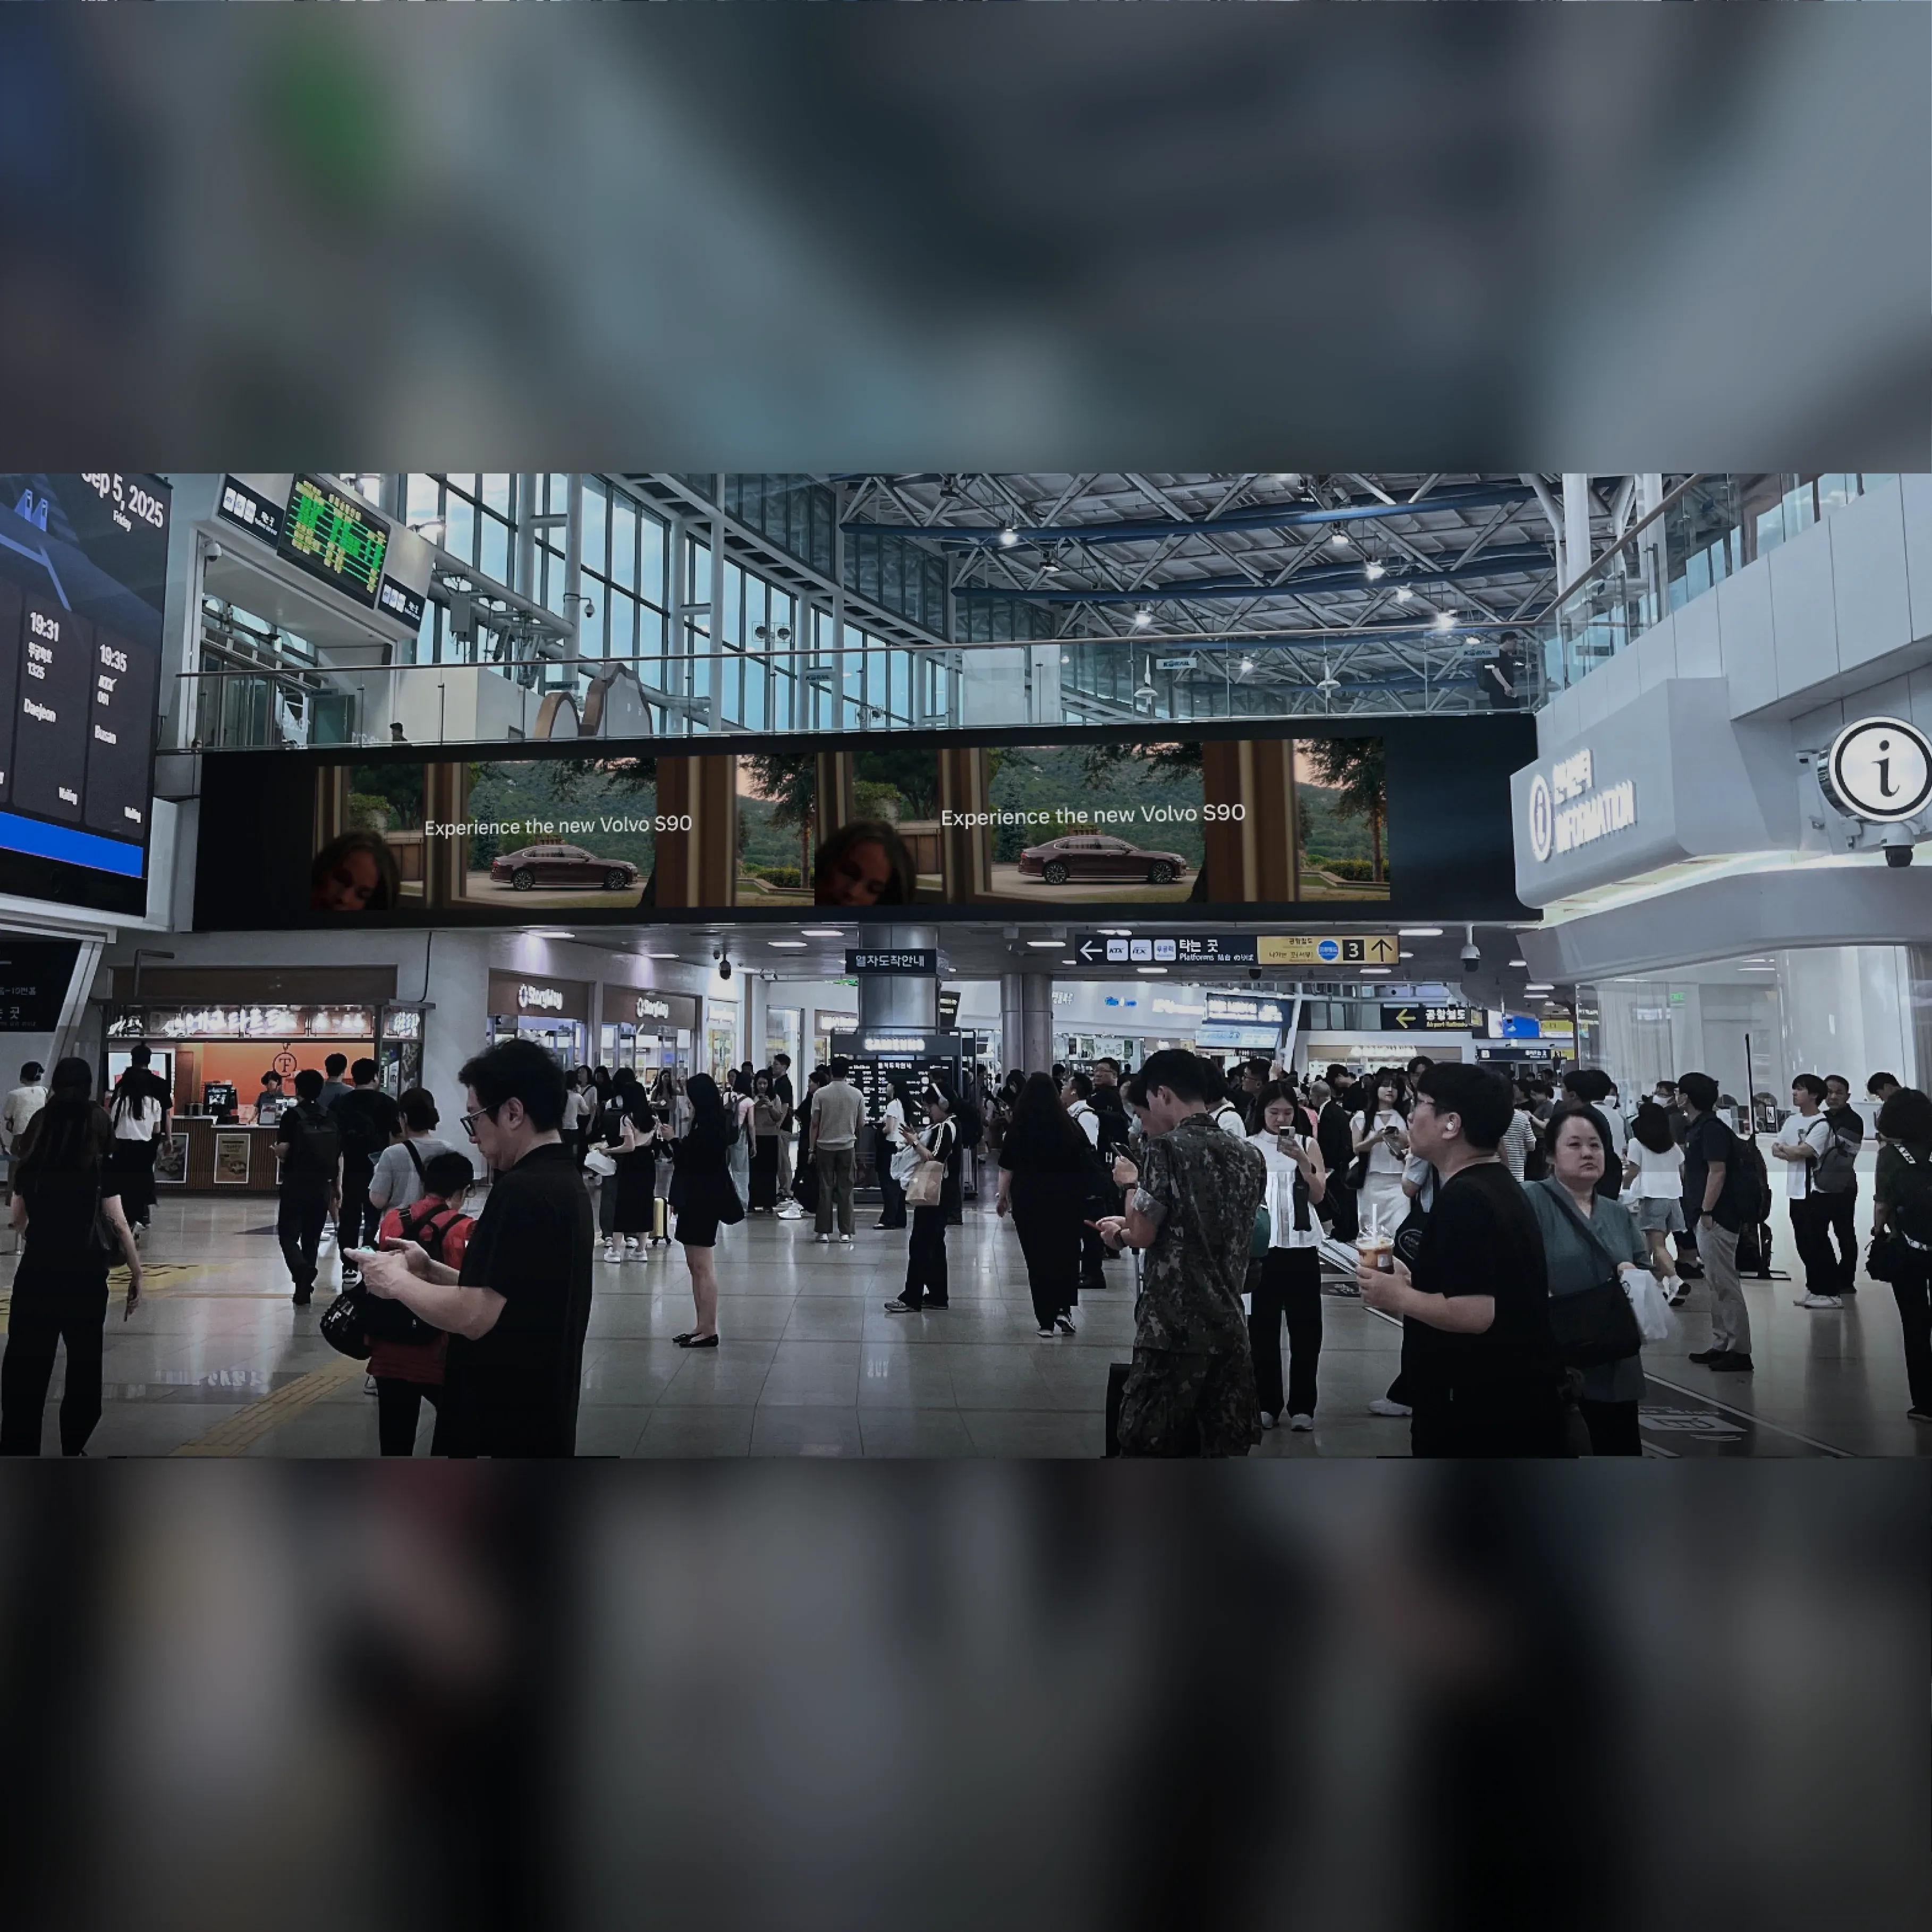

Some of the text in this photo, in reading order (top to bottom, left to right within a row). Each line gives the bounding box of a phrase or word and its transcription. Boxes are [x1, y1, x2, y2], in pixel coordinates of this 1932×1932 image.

[112, 473, 125, 511] 5,
[129, 485, 163, 528] 2025
[30, 612, 60, 642] 19:31
[100, 644, 127, 672] 19:35
[24, 698, 56, 722] Daejeon
[425, 815, 692, 839] Experience the new Volvo S90
[941, 804, 1245, 829] Experience the new Volvo S90
[1179, 939, 1218, 953] 타는 곳
[1349, 943, 1359, 957] 3
